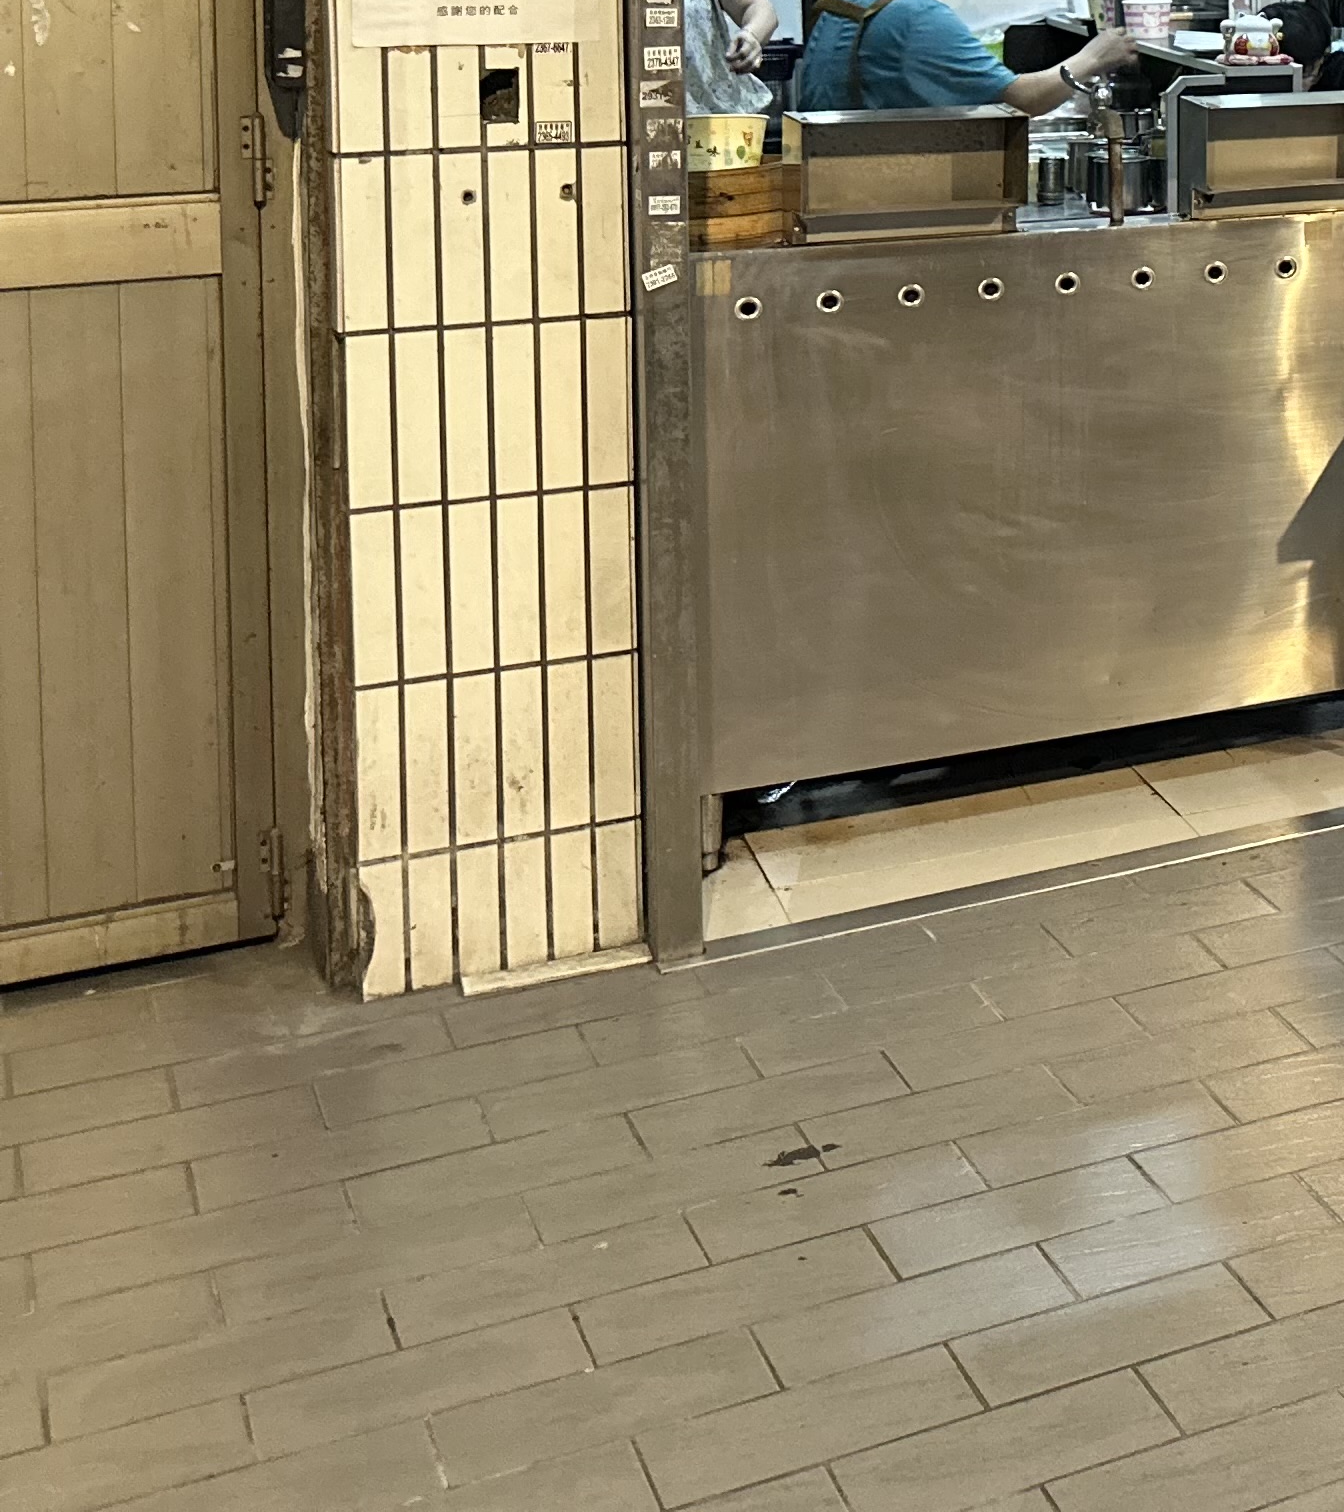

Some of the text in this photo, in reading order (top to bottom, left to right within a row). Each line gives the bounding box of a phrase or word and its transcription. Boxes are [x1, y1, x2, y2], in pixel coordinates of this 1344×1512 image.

[436, 5, 519, 17] 感謝您的配合
